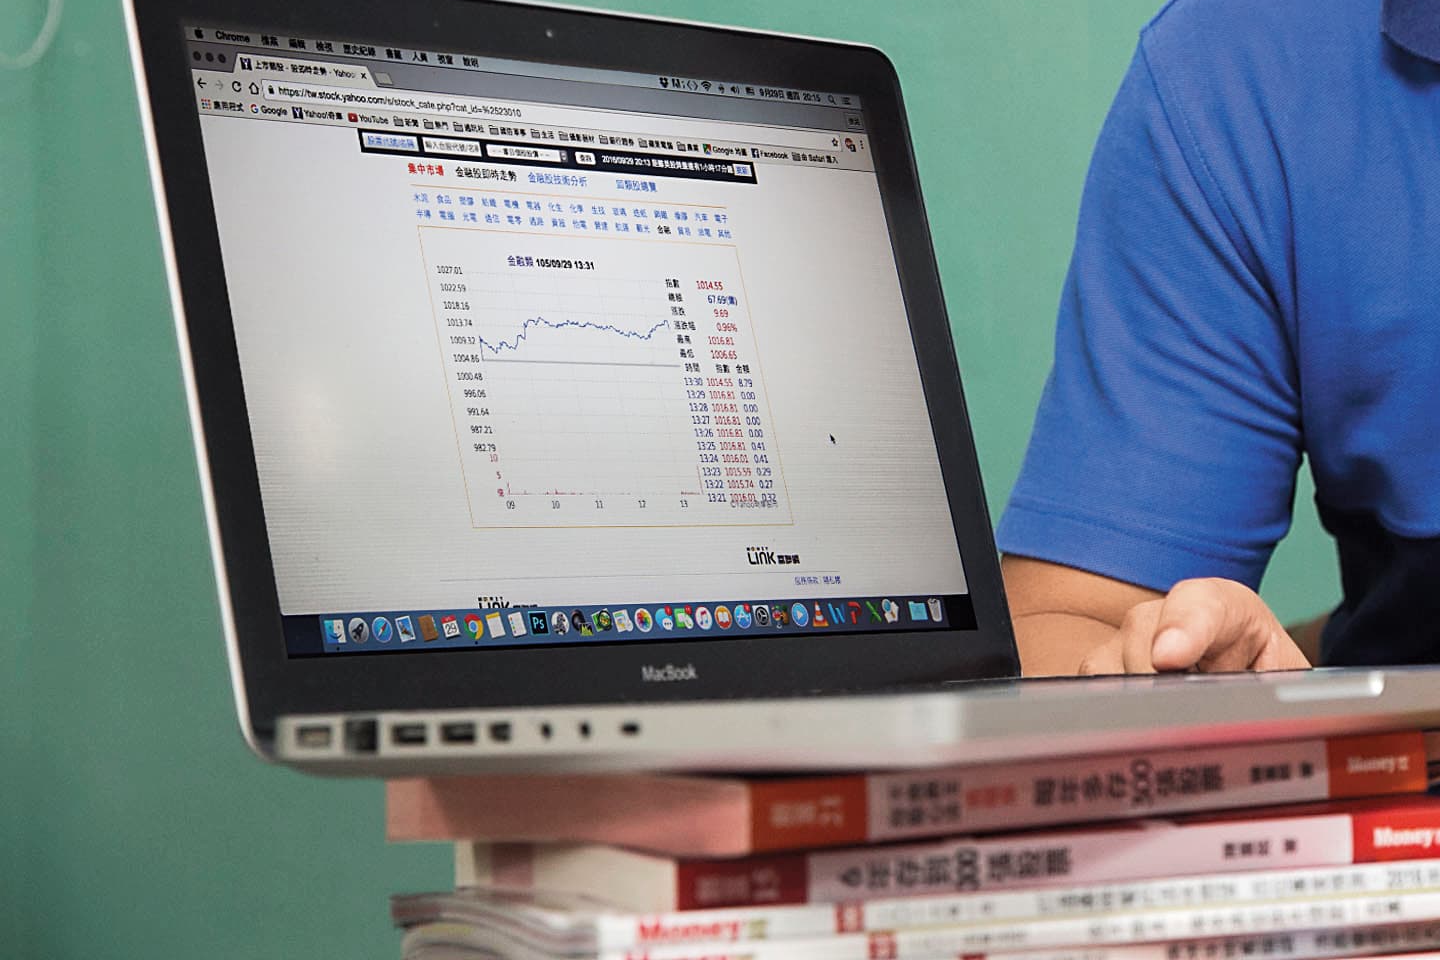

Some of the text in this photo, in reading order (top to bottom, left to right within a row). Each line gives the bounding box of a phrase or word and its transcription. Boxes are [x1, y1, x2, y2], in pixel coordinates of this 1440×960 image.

[215, 31, 250, 43] Chrome
[261, 105, 288, 118] Google
[358, 114, 389, 125] YouTube
[712, 145, 734, 157] Google
[760, 150, 789, 161] Facebook
[408, 163, 445, 176] 集中市場
[715, 214, 728, 223] 電子
[535, 258, 573, 269] 105/09/29
[574, 260, 595, 271] 13:31
[436, 265, 463, 275] 1027.01
[440, 283, 467, 293] 1022.59
[696, 280, 723, 290] 1014.55
[714, 309, 728, 318] 9.69
[447, 318, 472, 327] 1013.74
[716, 322, 738, 332] 0.96%
[456, 372, 483, 381] 1000.48
[463, 389, 487, 398] 996.06
[687, 390, 705, 399] 13:29
[741, 392, 755, 400] 0.00
[466, 407, 490, 417] 991.64
[689, 403, 708, 412] 13:28
[744, 404, 758, 412] 0.00
[692, 416, 709, 425] 13:27
[746, 417, 760, 425] 0.00
[470, 425, 493, 434] 987.21
[694, 428, 714, 438] 13:26
[749, 429, 763, 438] 0.00
[473, 443, 497, 453] 982.79
[697, 442, 716, 450] 13:25
[751, 442, 765, 451] 0.41
[700, 454, 718, 463] 13:24
[754, 455, 768, 463] 0.41
[702, 467, 721, 476] 13:23
[705, 480, 724, 488] 13:22
[759, 480, 773, 489] 0.27
[708, 493, 726, 502] 13:21
[532, 616, 545, 630] Ps
[445, 622, 458, 635] 29
[641, 663, 698, 682] MacBook
